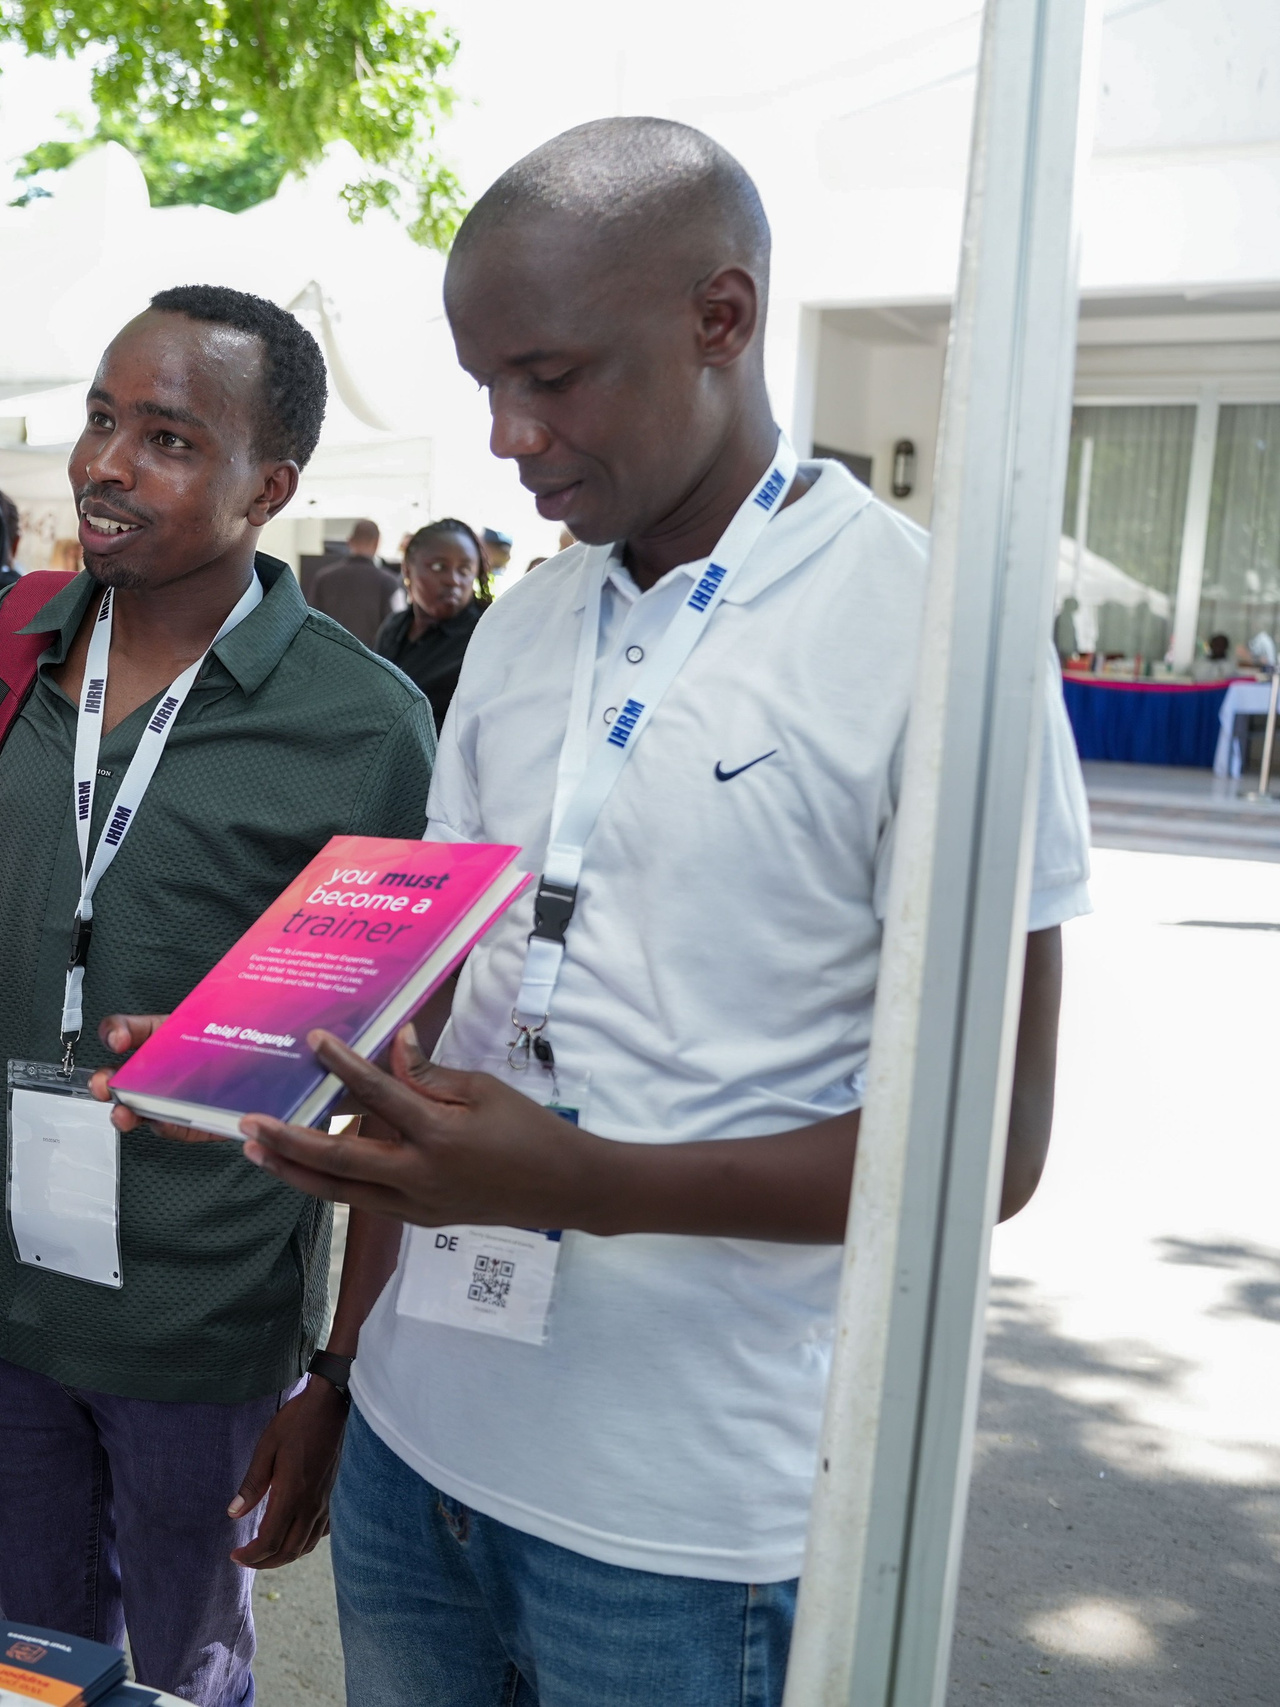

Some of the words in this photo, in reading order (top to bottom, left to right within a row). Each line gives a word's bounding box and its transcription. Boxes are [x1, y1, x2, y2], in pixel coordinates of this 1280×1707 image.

[753, 468, 786, 512] IHRM
[687, 562, 728, 613] IHRM
[84, 679, 105, 714] IHRM
[148, 696, 179, 734] IHRM
[607, 698, 646, 749] IHRM
[78, 780, 91, 821] IHRM
[104, 805, 133, 846] IHRM
[324, 868, 379, 886] you
[379, 871, 450, 890] must
[306, 885, 410, 911] become
[411, 898, 433, 914] a
[282, 908, 414, 944] trainer
[203, 1022, 240, 1039] Bolaji
[239, 1028, 296, 1048] Olagunju
[434, 1233, 459, 1251] DE
[7, 1632, 52, 1648] Business
[51, 1642, 72, 1653] Your
